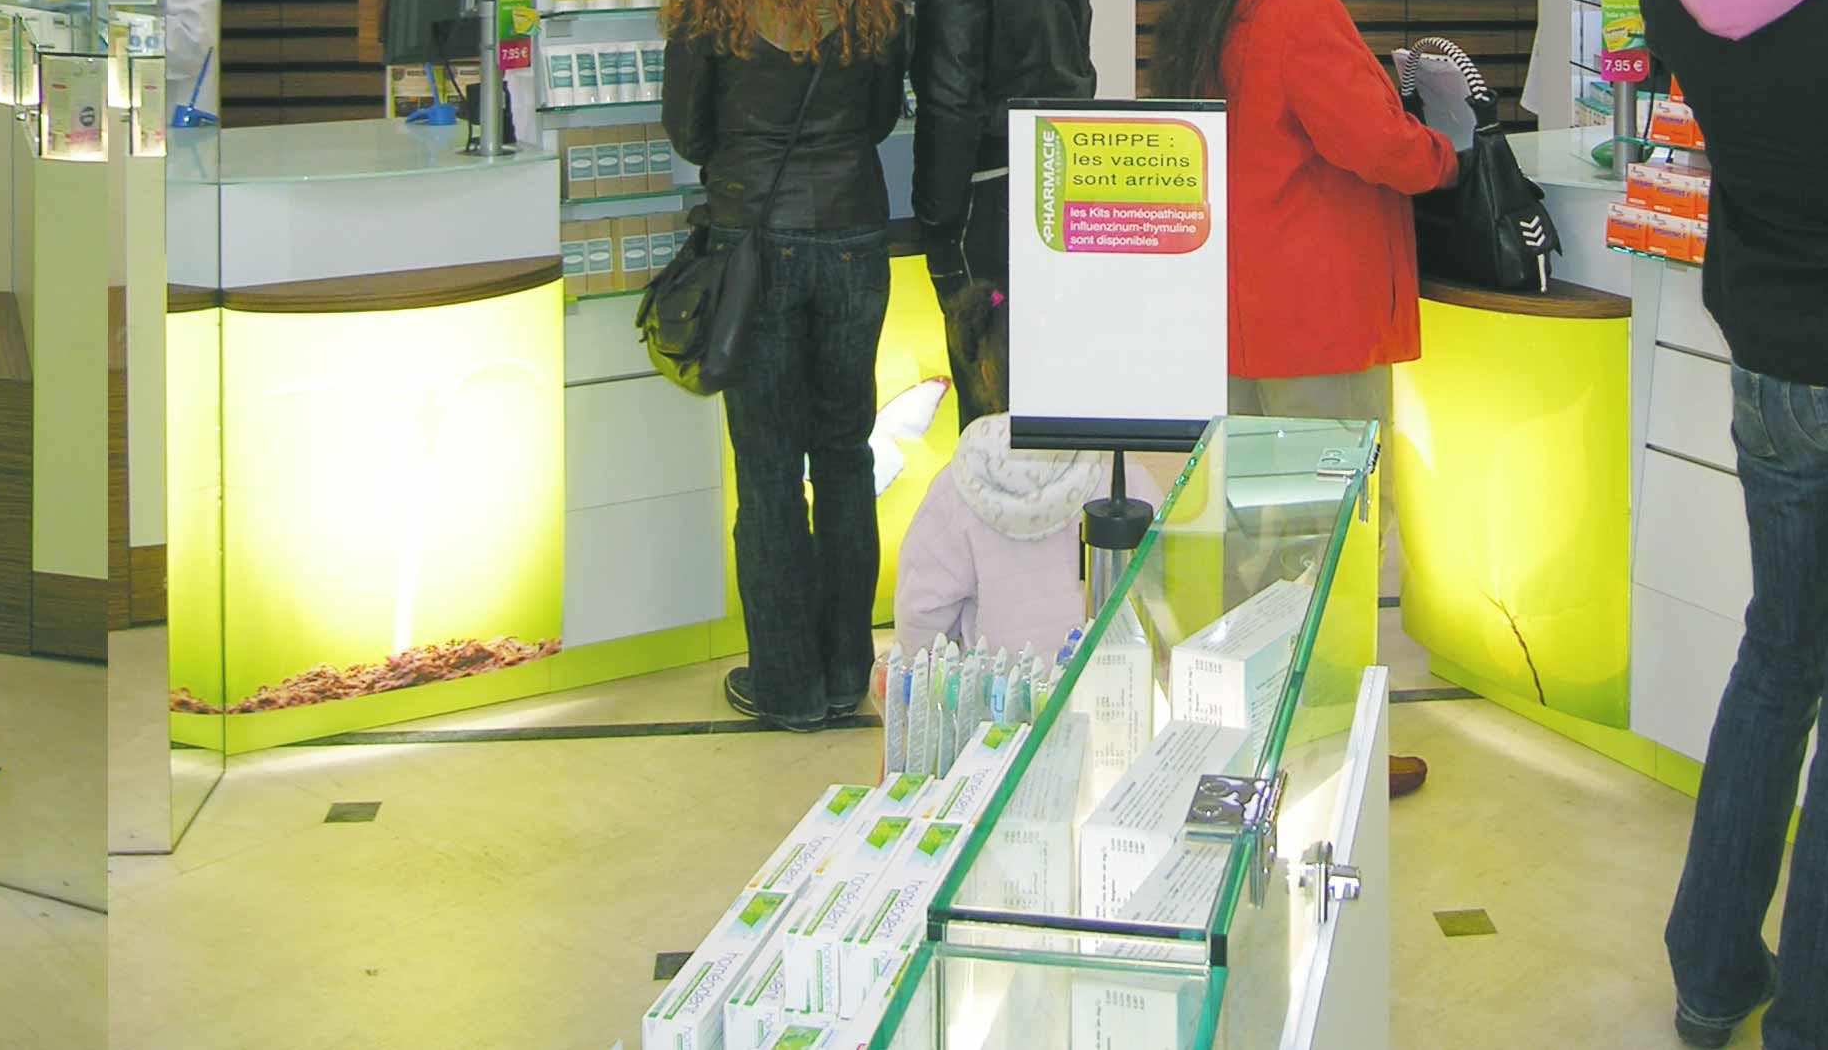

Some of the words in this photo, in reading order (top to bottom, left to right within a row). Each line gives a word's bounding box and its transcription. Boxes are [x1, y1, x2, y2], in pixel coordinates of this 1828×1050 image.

[1073, 132, 1161, 148] GRIPPE
[1073, 152, 1103, 167] les
[1111, 152, 1191, 168] vaccins
[1042, 129, 1056, 234] PHARMACIE
[1073, 174, 1117, 186] sont
[1125, 173, 1198, 187] arrivés
[1070, 207, 1088, 218] les
[1089, 207, 1111, 219] Kits
[1112, 207, 1205, 222] homéopathiques
[1070, 221, 1197, 235] influenzinum-thymuline
[1070, 235, 1095, 246] sont
[1096, 234, 1160, 248] disponibles
